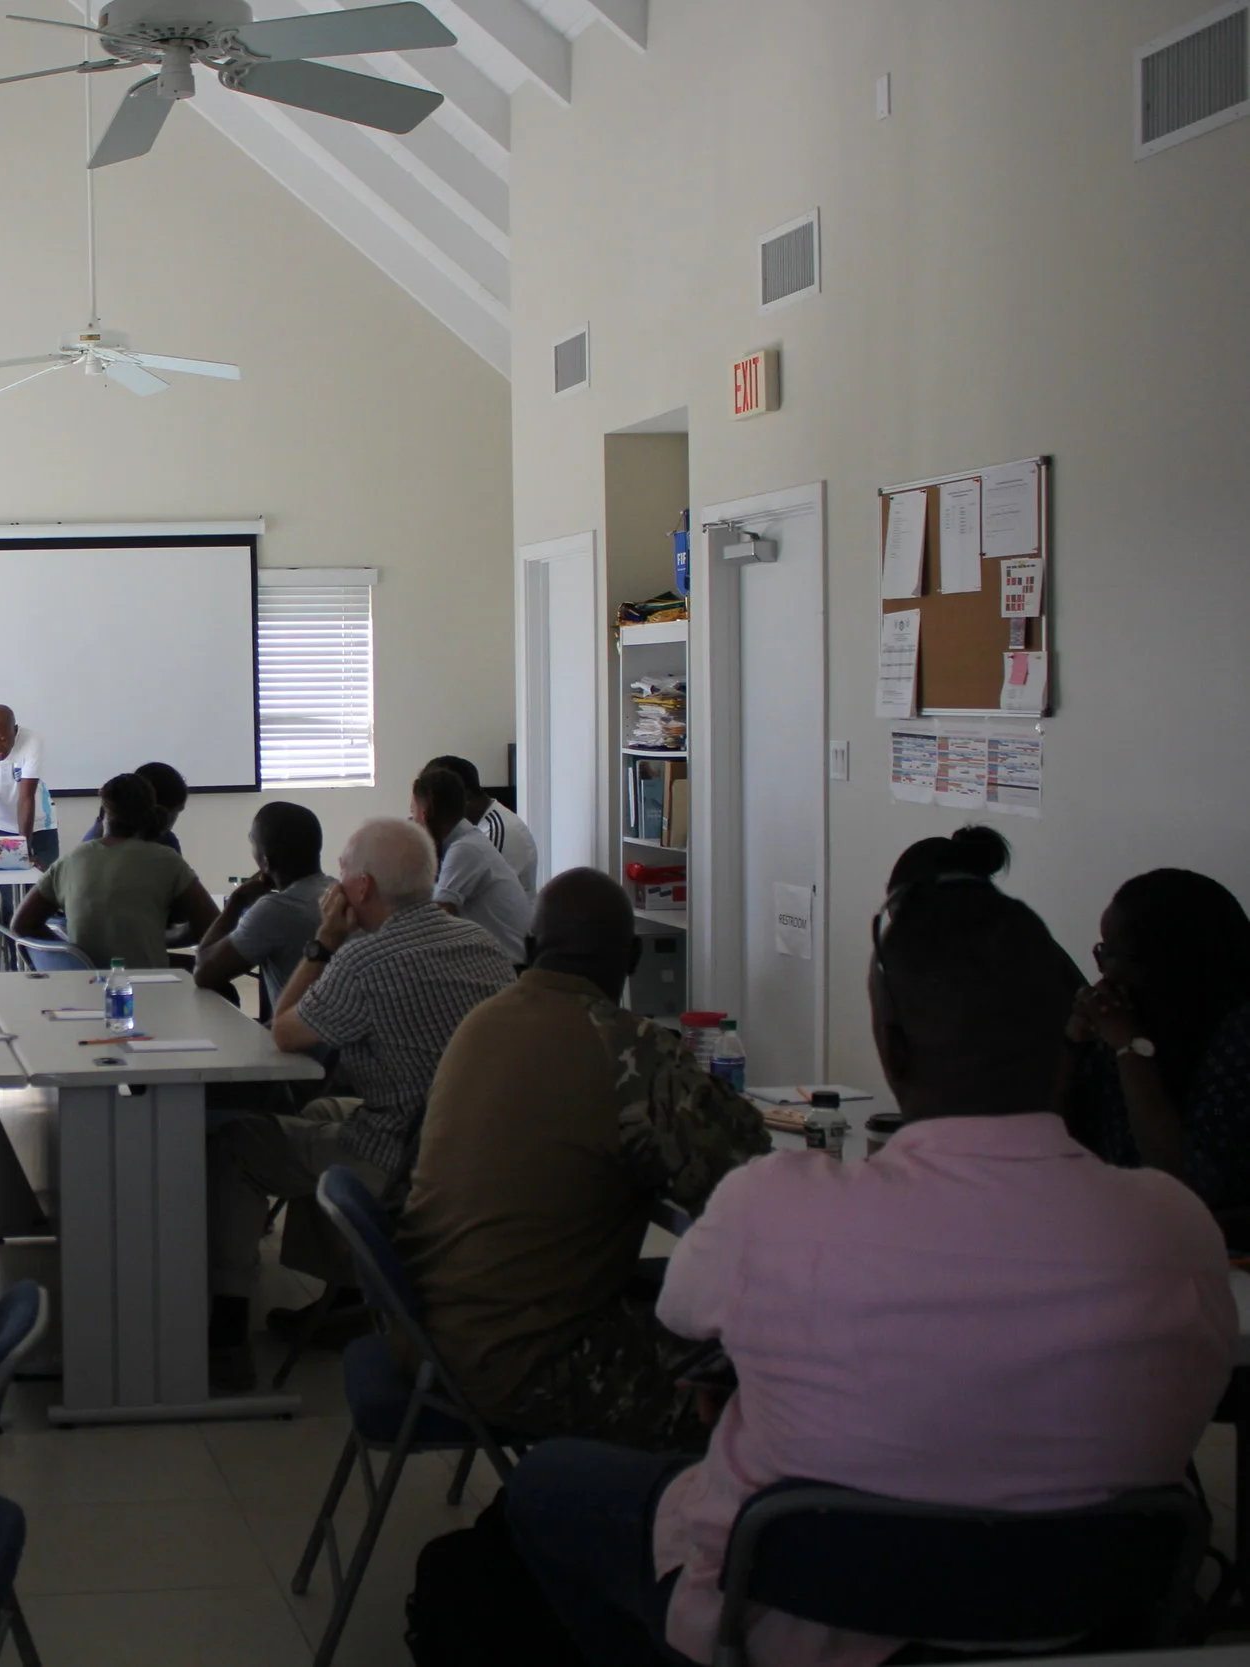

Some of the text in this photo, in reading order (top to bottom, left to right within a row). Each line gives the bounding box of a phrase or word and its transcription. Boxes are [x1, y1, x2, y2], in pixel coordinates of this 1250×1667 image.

[734, 356, 759, 414] EXIT
[677, 552, 686, 566] FIF
[779, 914, 806, 929] RESTROOM
